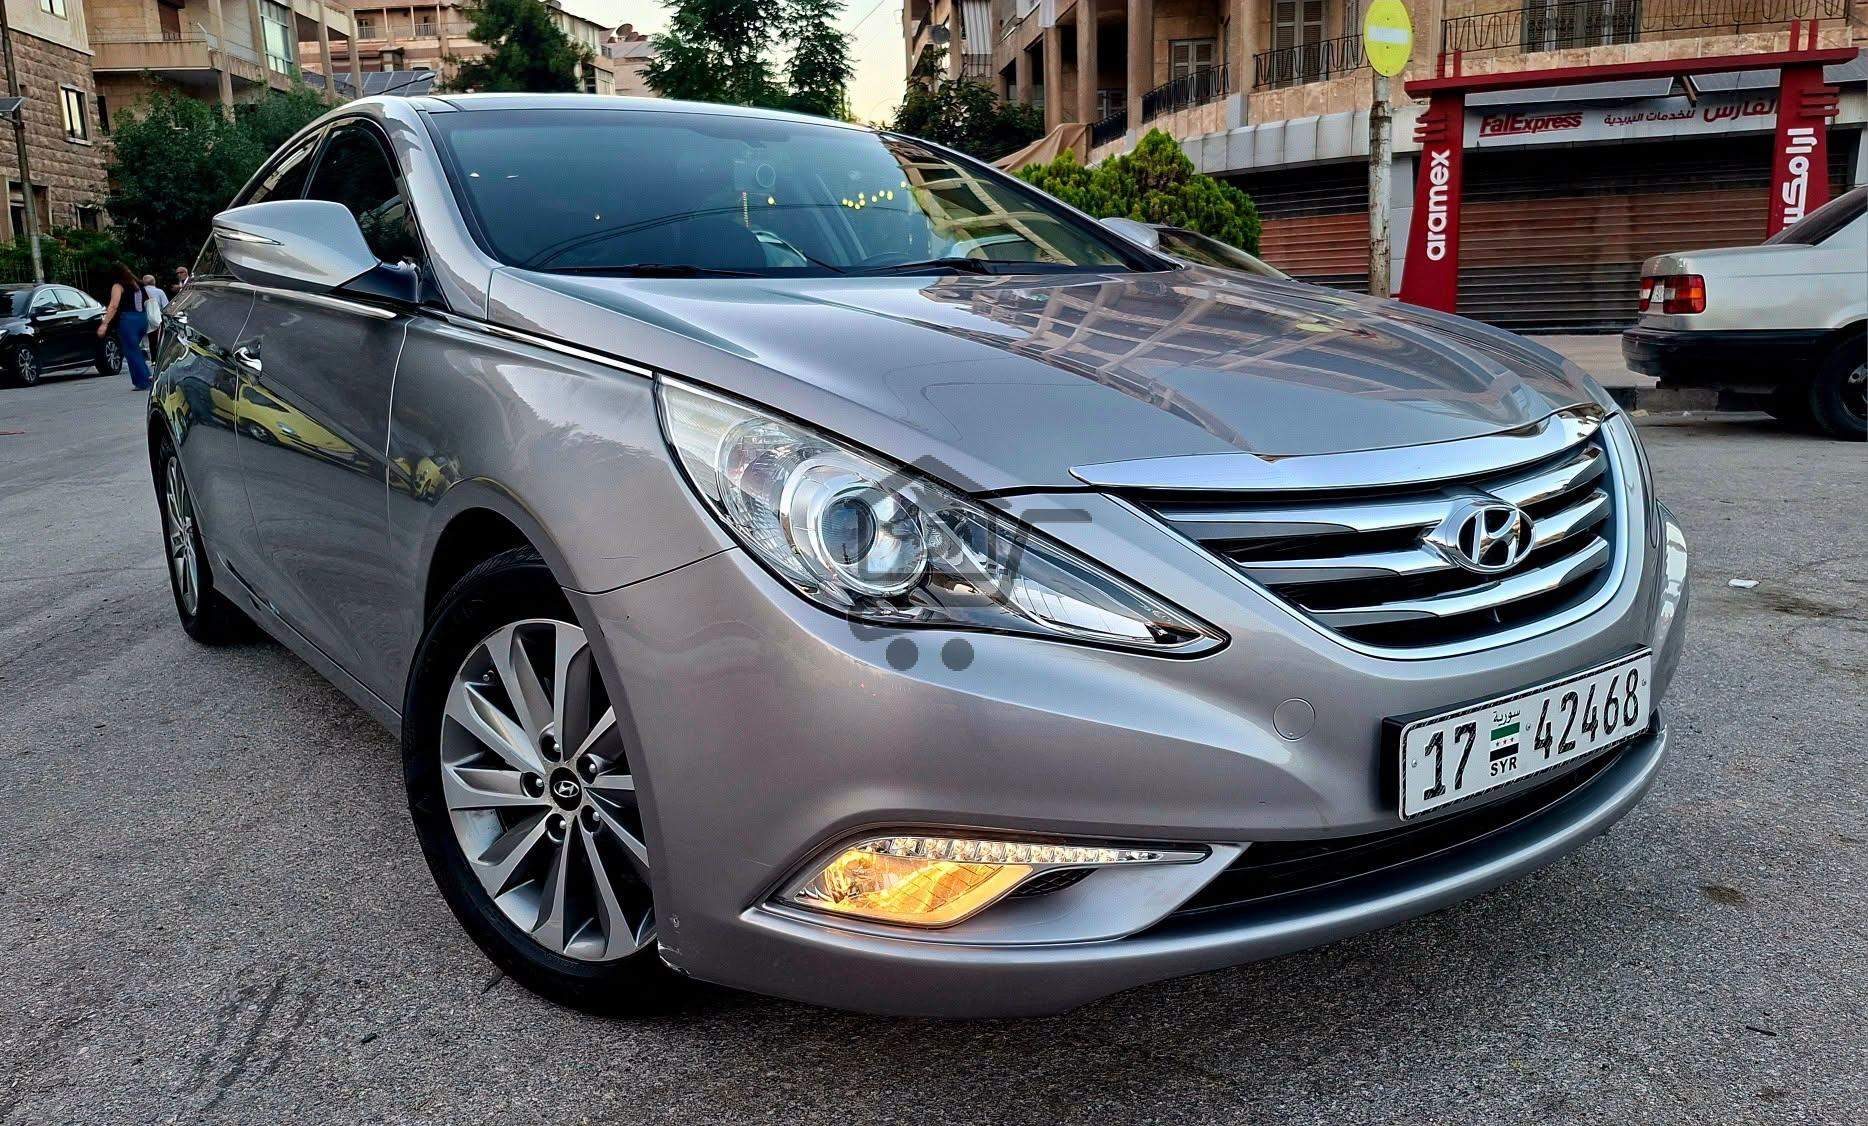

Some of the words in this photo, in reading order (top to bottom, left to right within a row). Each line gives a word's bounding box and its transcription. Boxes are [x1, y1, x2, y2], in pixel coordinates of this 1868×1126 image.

[1646, 109, 1696, 122] للخدمات
[1426, 149, 1451, 261] aramex
[1493, 710, 1520, 726] سورية
[1424, 722, 1476, 801] 17
[1534, 668, 1639, 759] 42468
[1490, 756, 1517, 777] SYR
